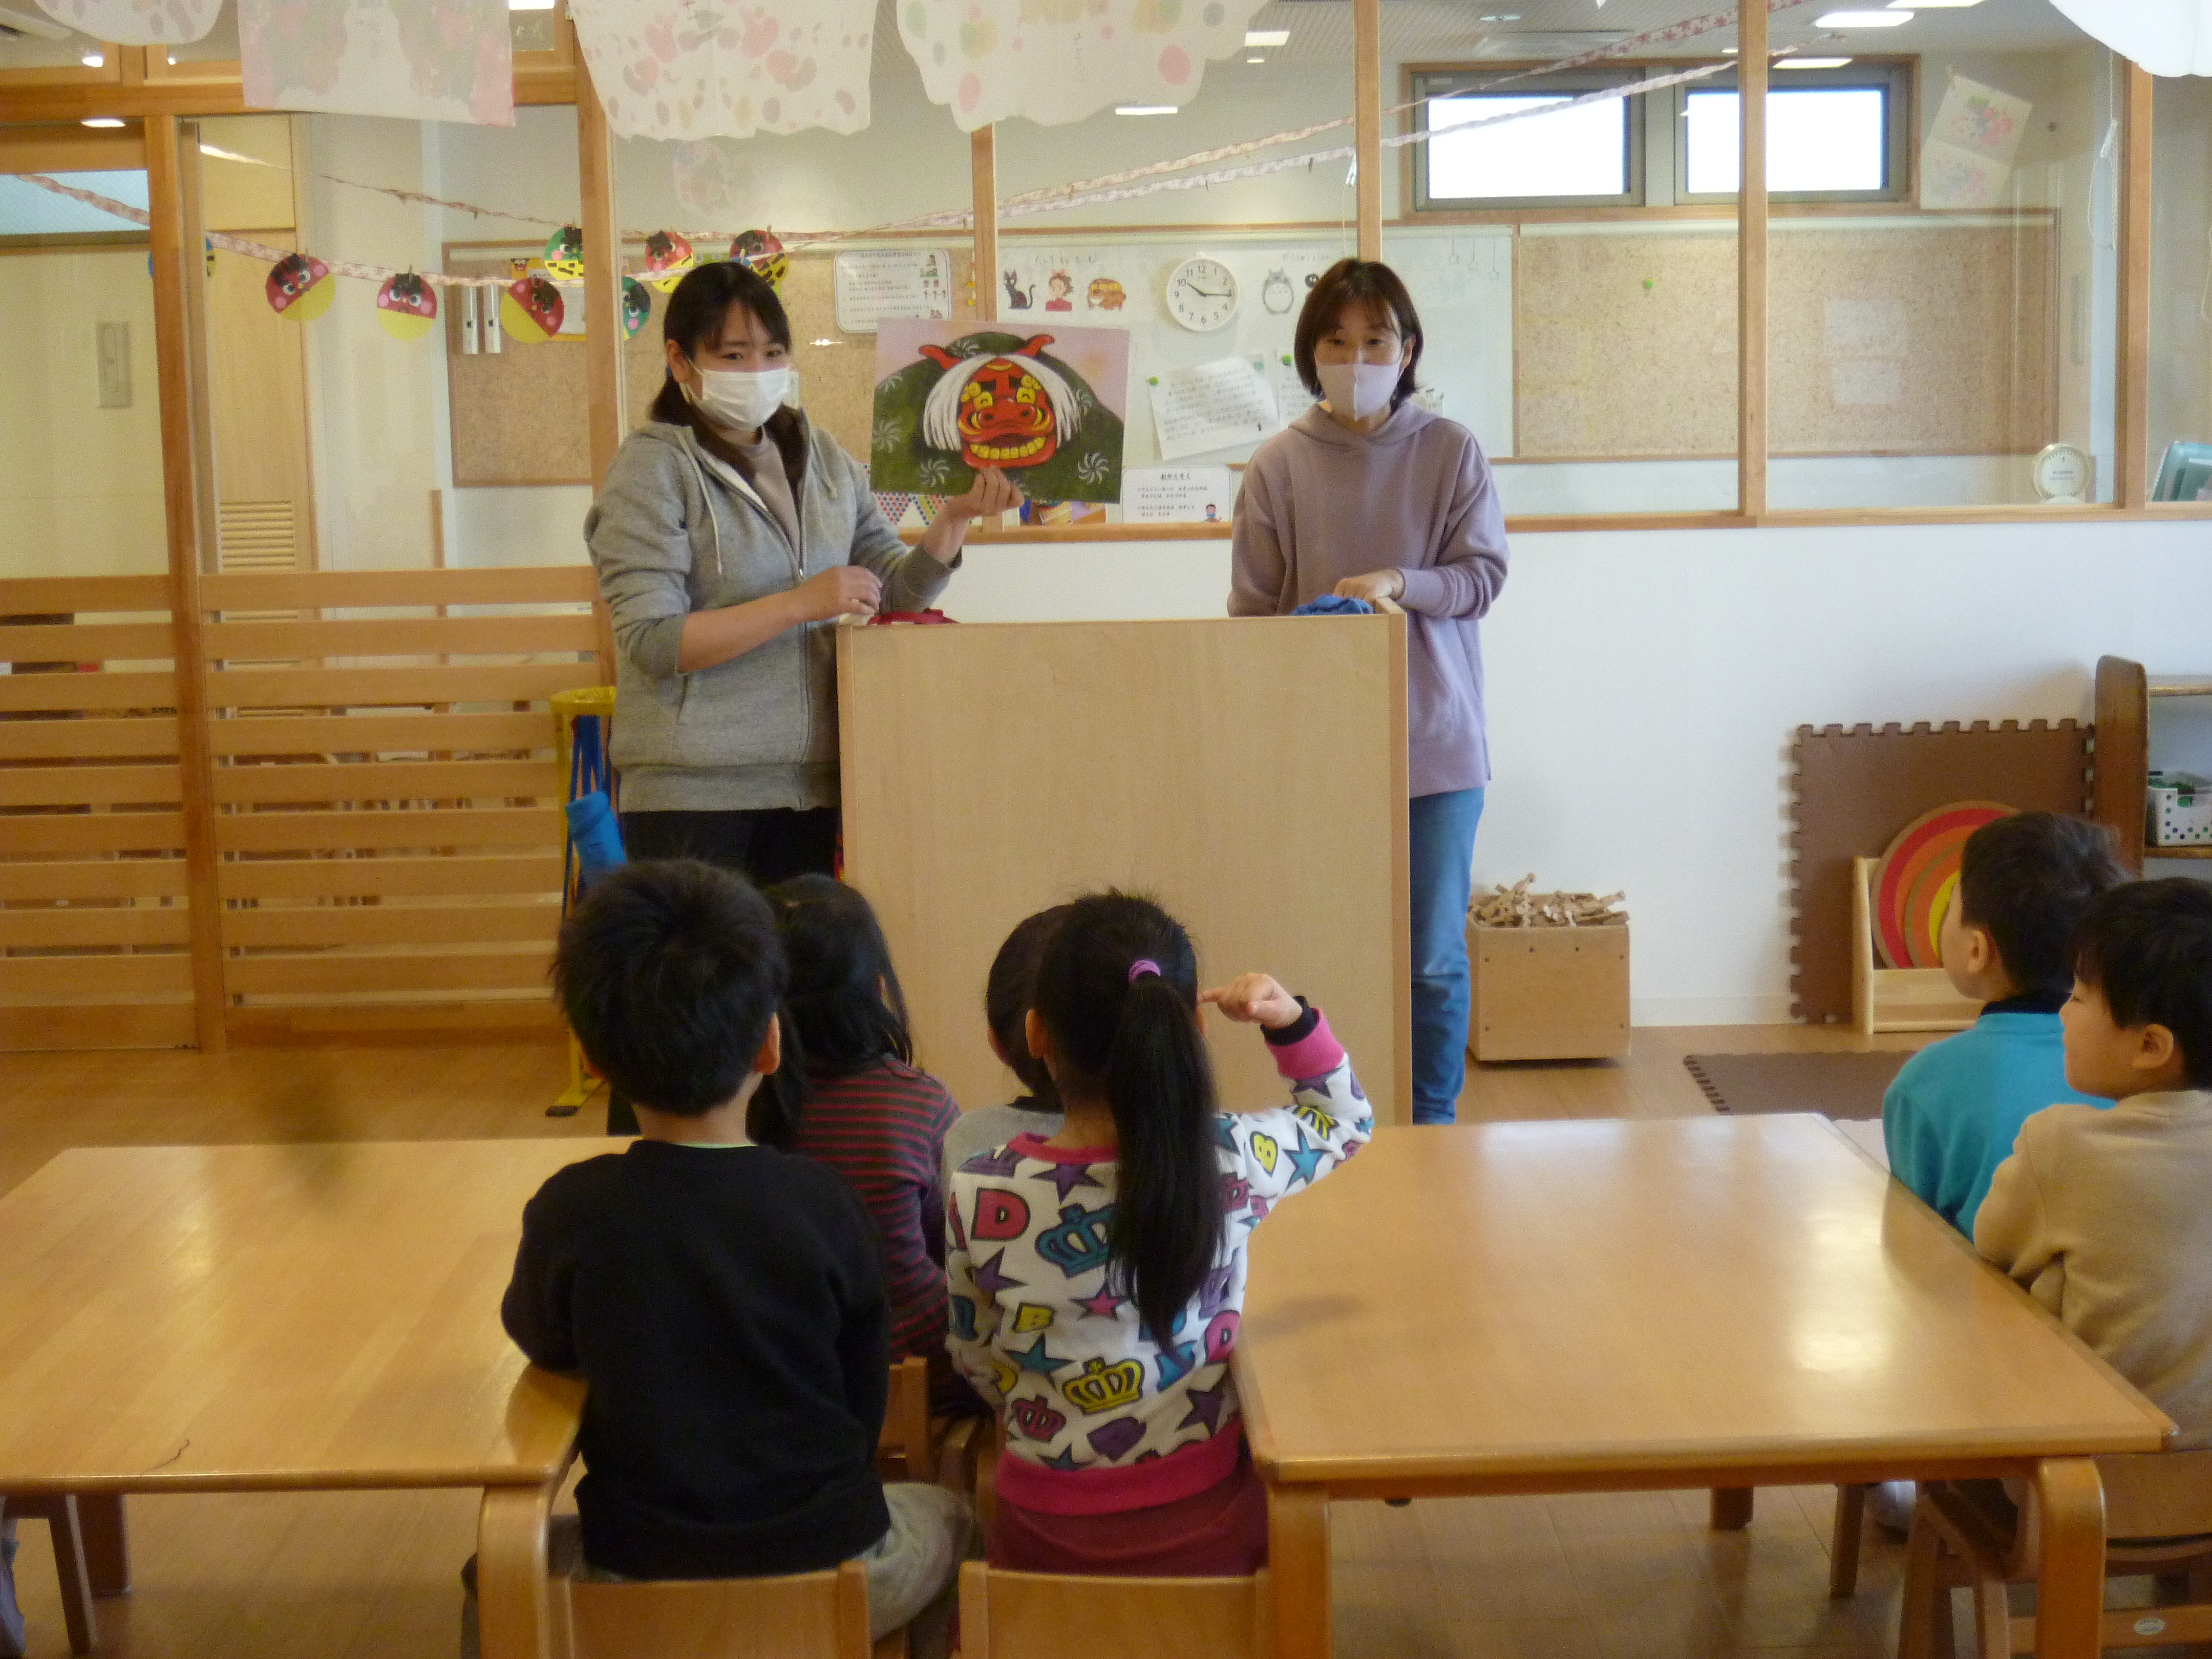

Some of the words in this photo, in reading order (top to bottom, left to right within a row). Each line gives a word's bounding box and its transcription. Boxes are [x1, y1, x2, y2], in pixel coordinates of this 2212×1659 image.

[1186, 268, 1194, 276] 11
[1177, 279, 1186, 287] 10
[1179, 304, 1184, 312] 8
[1188, 312, 1194, 321] 7
[1201, 315, 1206, 324] 6
[1161, 472, 1190, 480] おやくそく
[970, 1186, 1030, 1241] D
